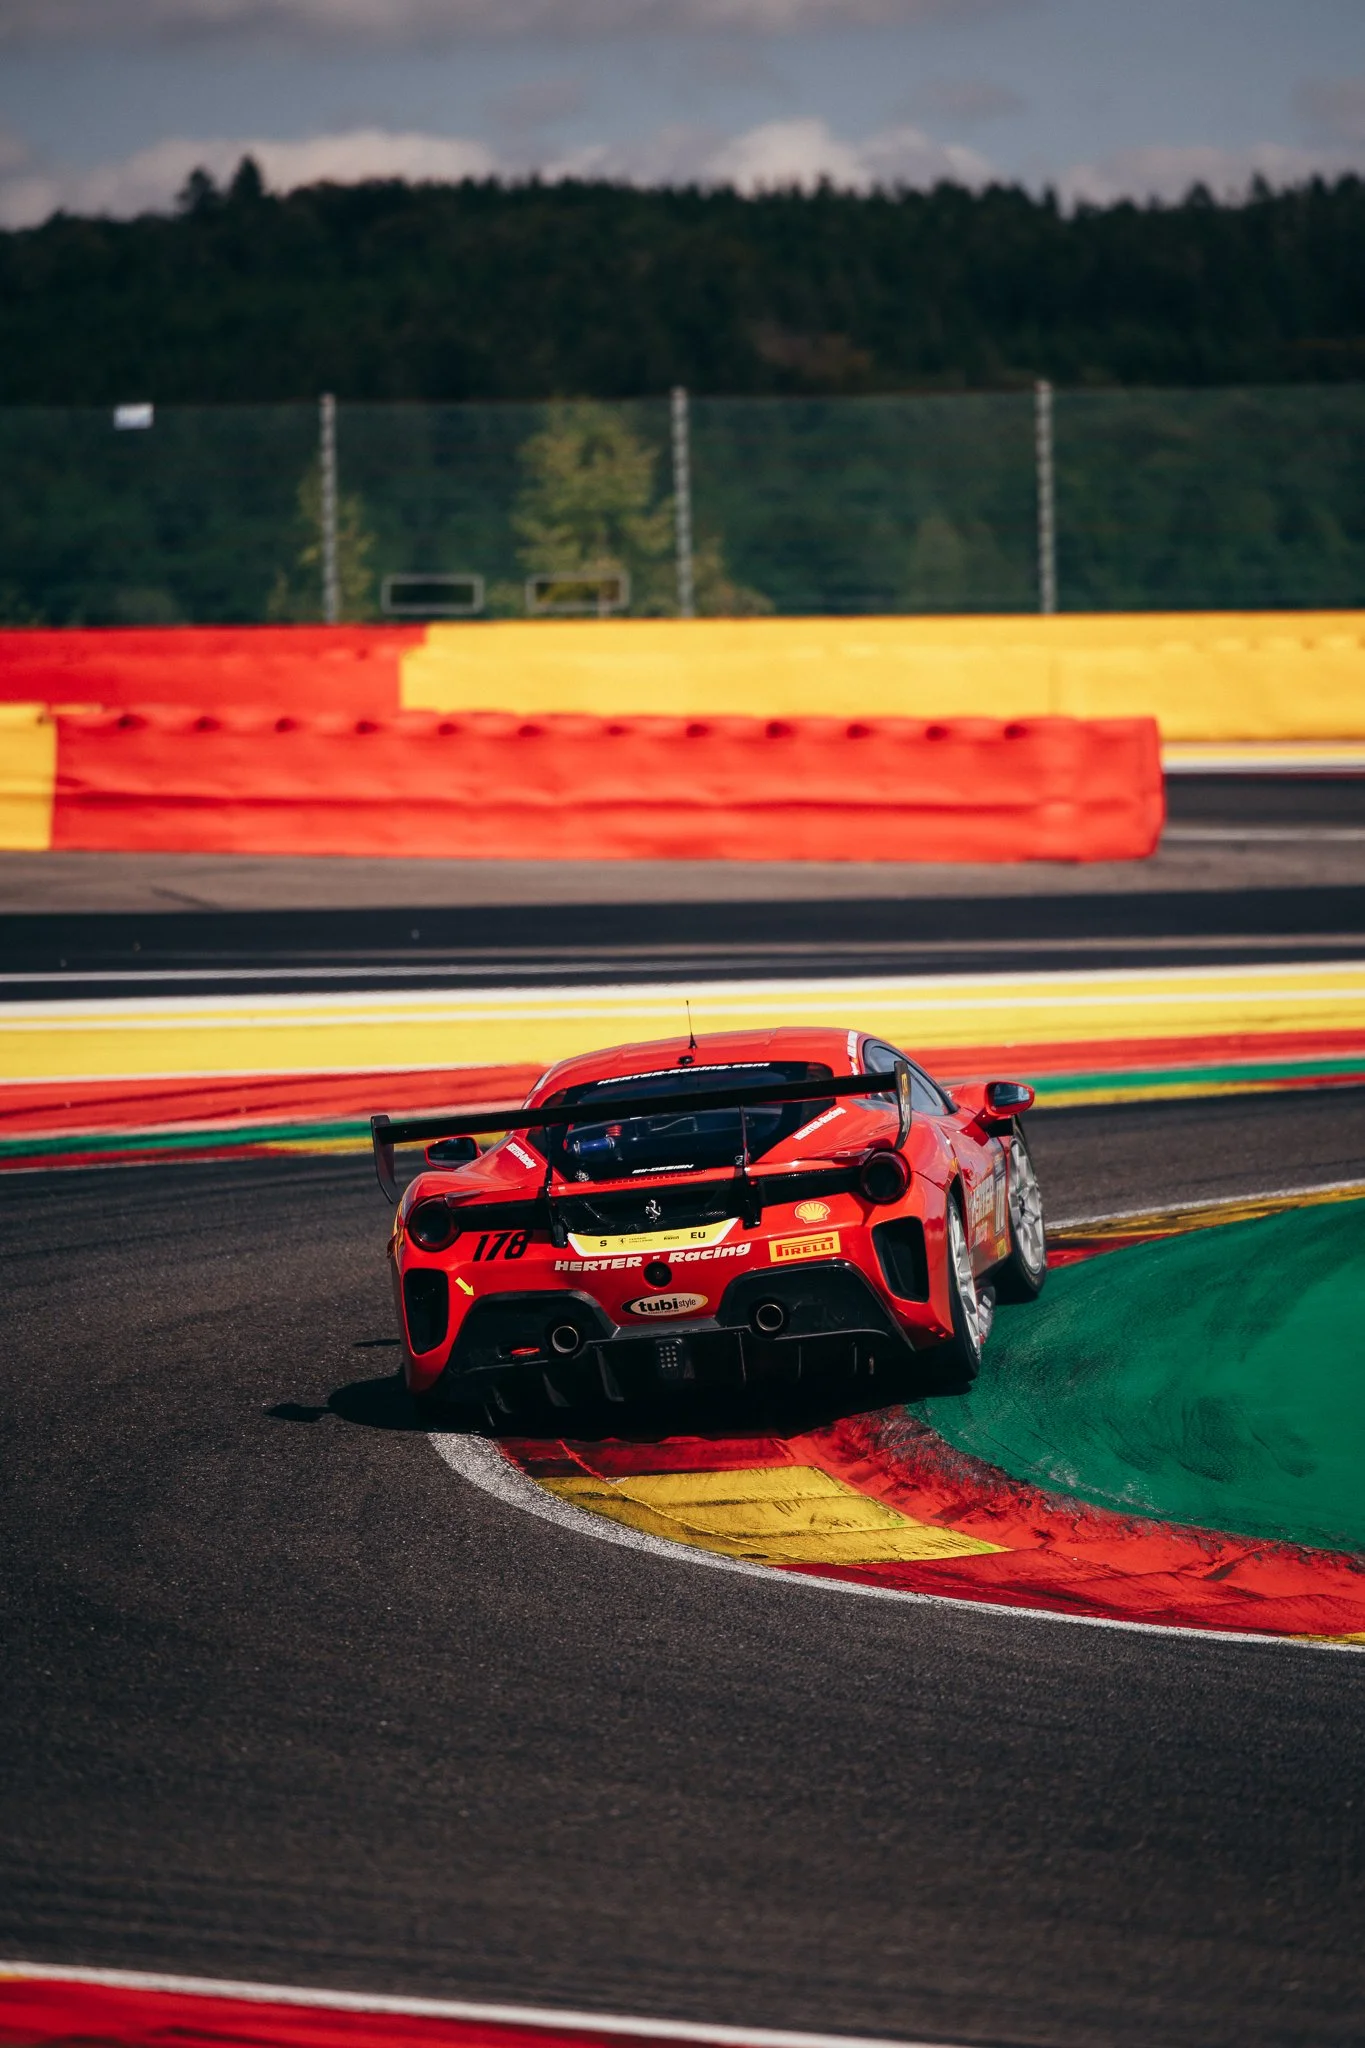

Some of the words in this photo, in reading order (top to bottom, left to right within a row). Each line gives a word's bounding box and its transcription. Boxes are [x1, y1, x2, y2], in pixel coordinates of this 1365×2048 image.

[599, 1239, 608, 1247] S
[690, 1231, 706, 1239] EU
[472, 1231, 531, 1262] 178
[776, 1236, 835, 1258] PIRELLI
[554, 1256, 643, 1272] HERTER
[668, 1242, 752, 1264] Racing
[638, 1298, 679, 1313] tubi
[678, 1298, 697, 1310] style
